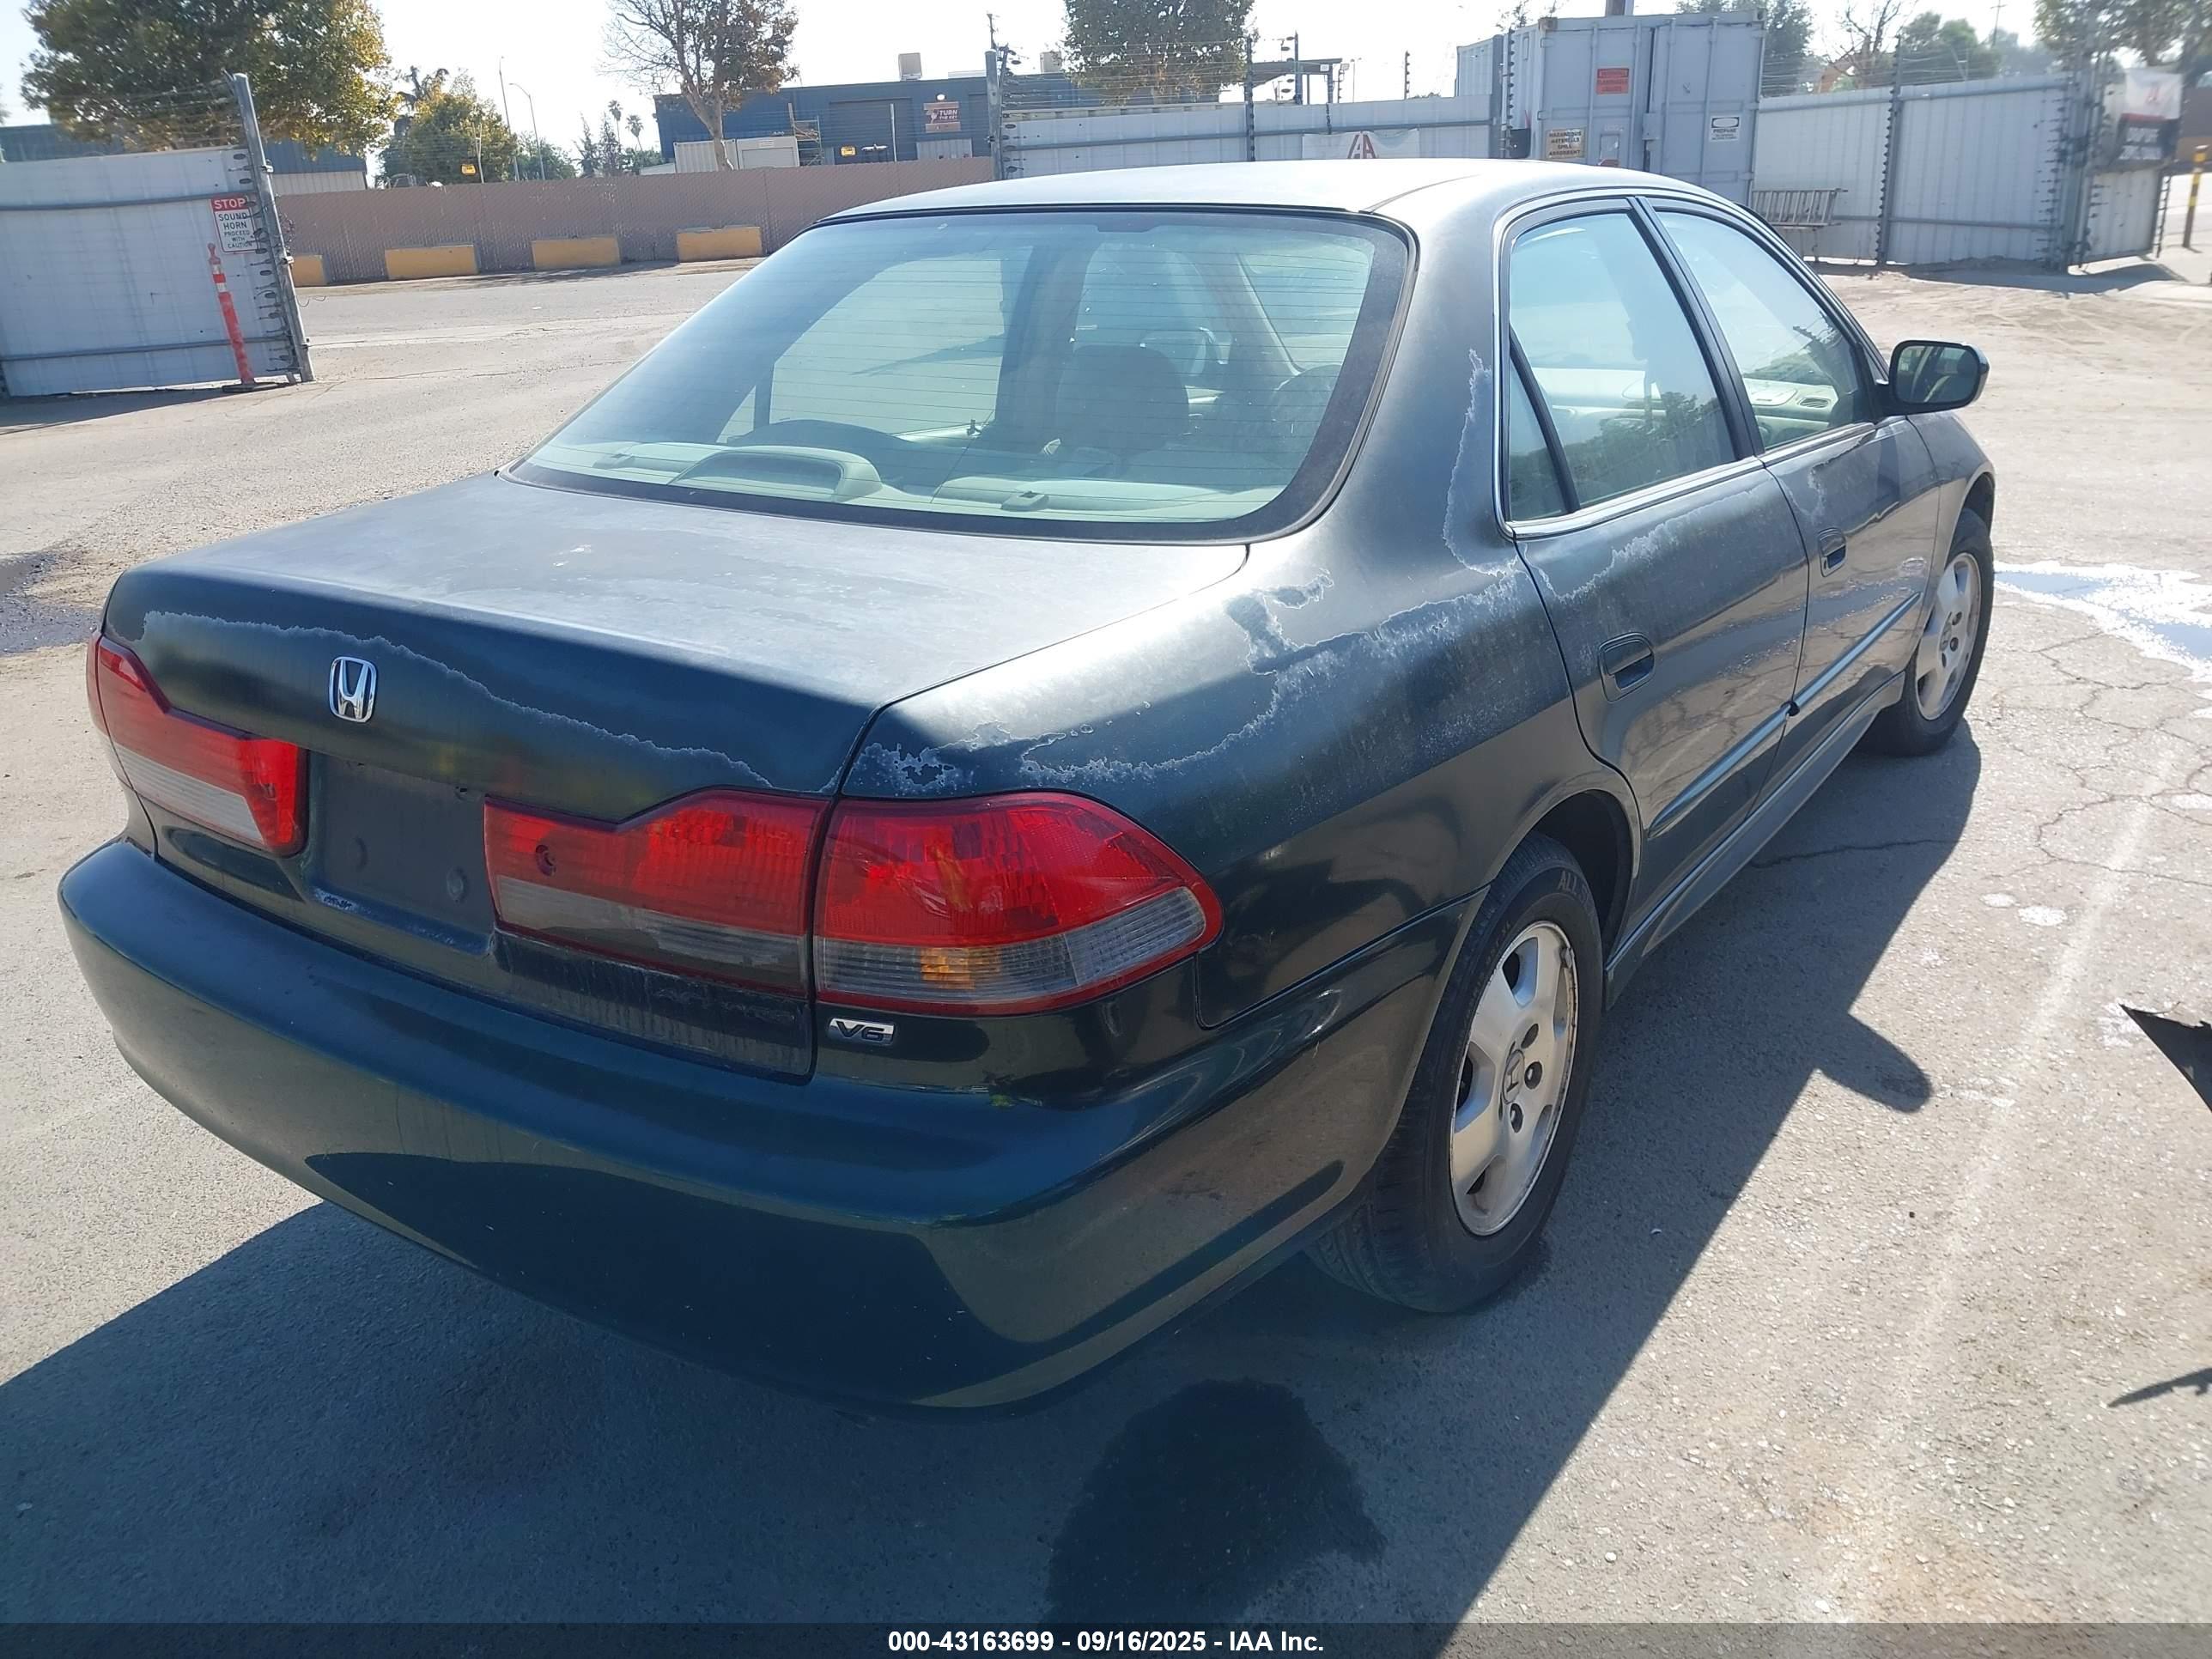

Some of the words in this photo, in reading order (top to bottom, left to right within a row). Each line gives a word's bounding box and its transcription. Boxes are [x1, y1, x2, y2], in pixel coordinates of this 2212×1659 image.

[214, 198, 246, 210] STOP
[219, 212, 247, 221] SOUND
[836, 1021, 885, 1042] V6
